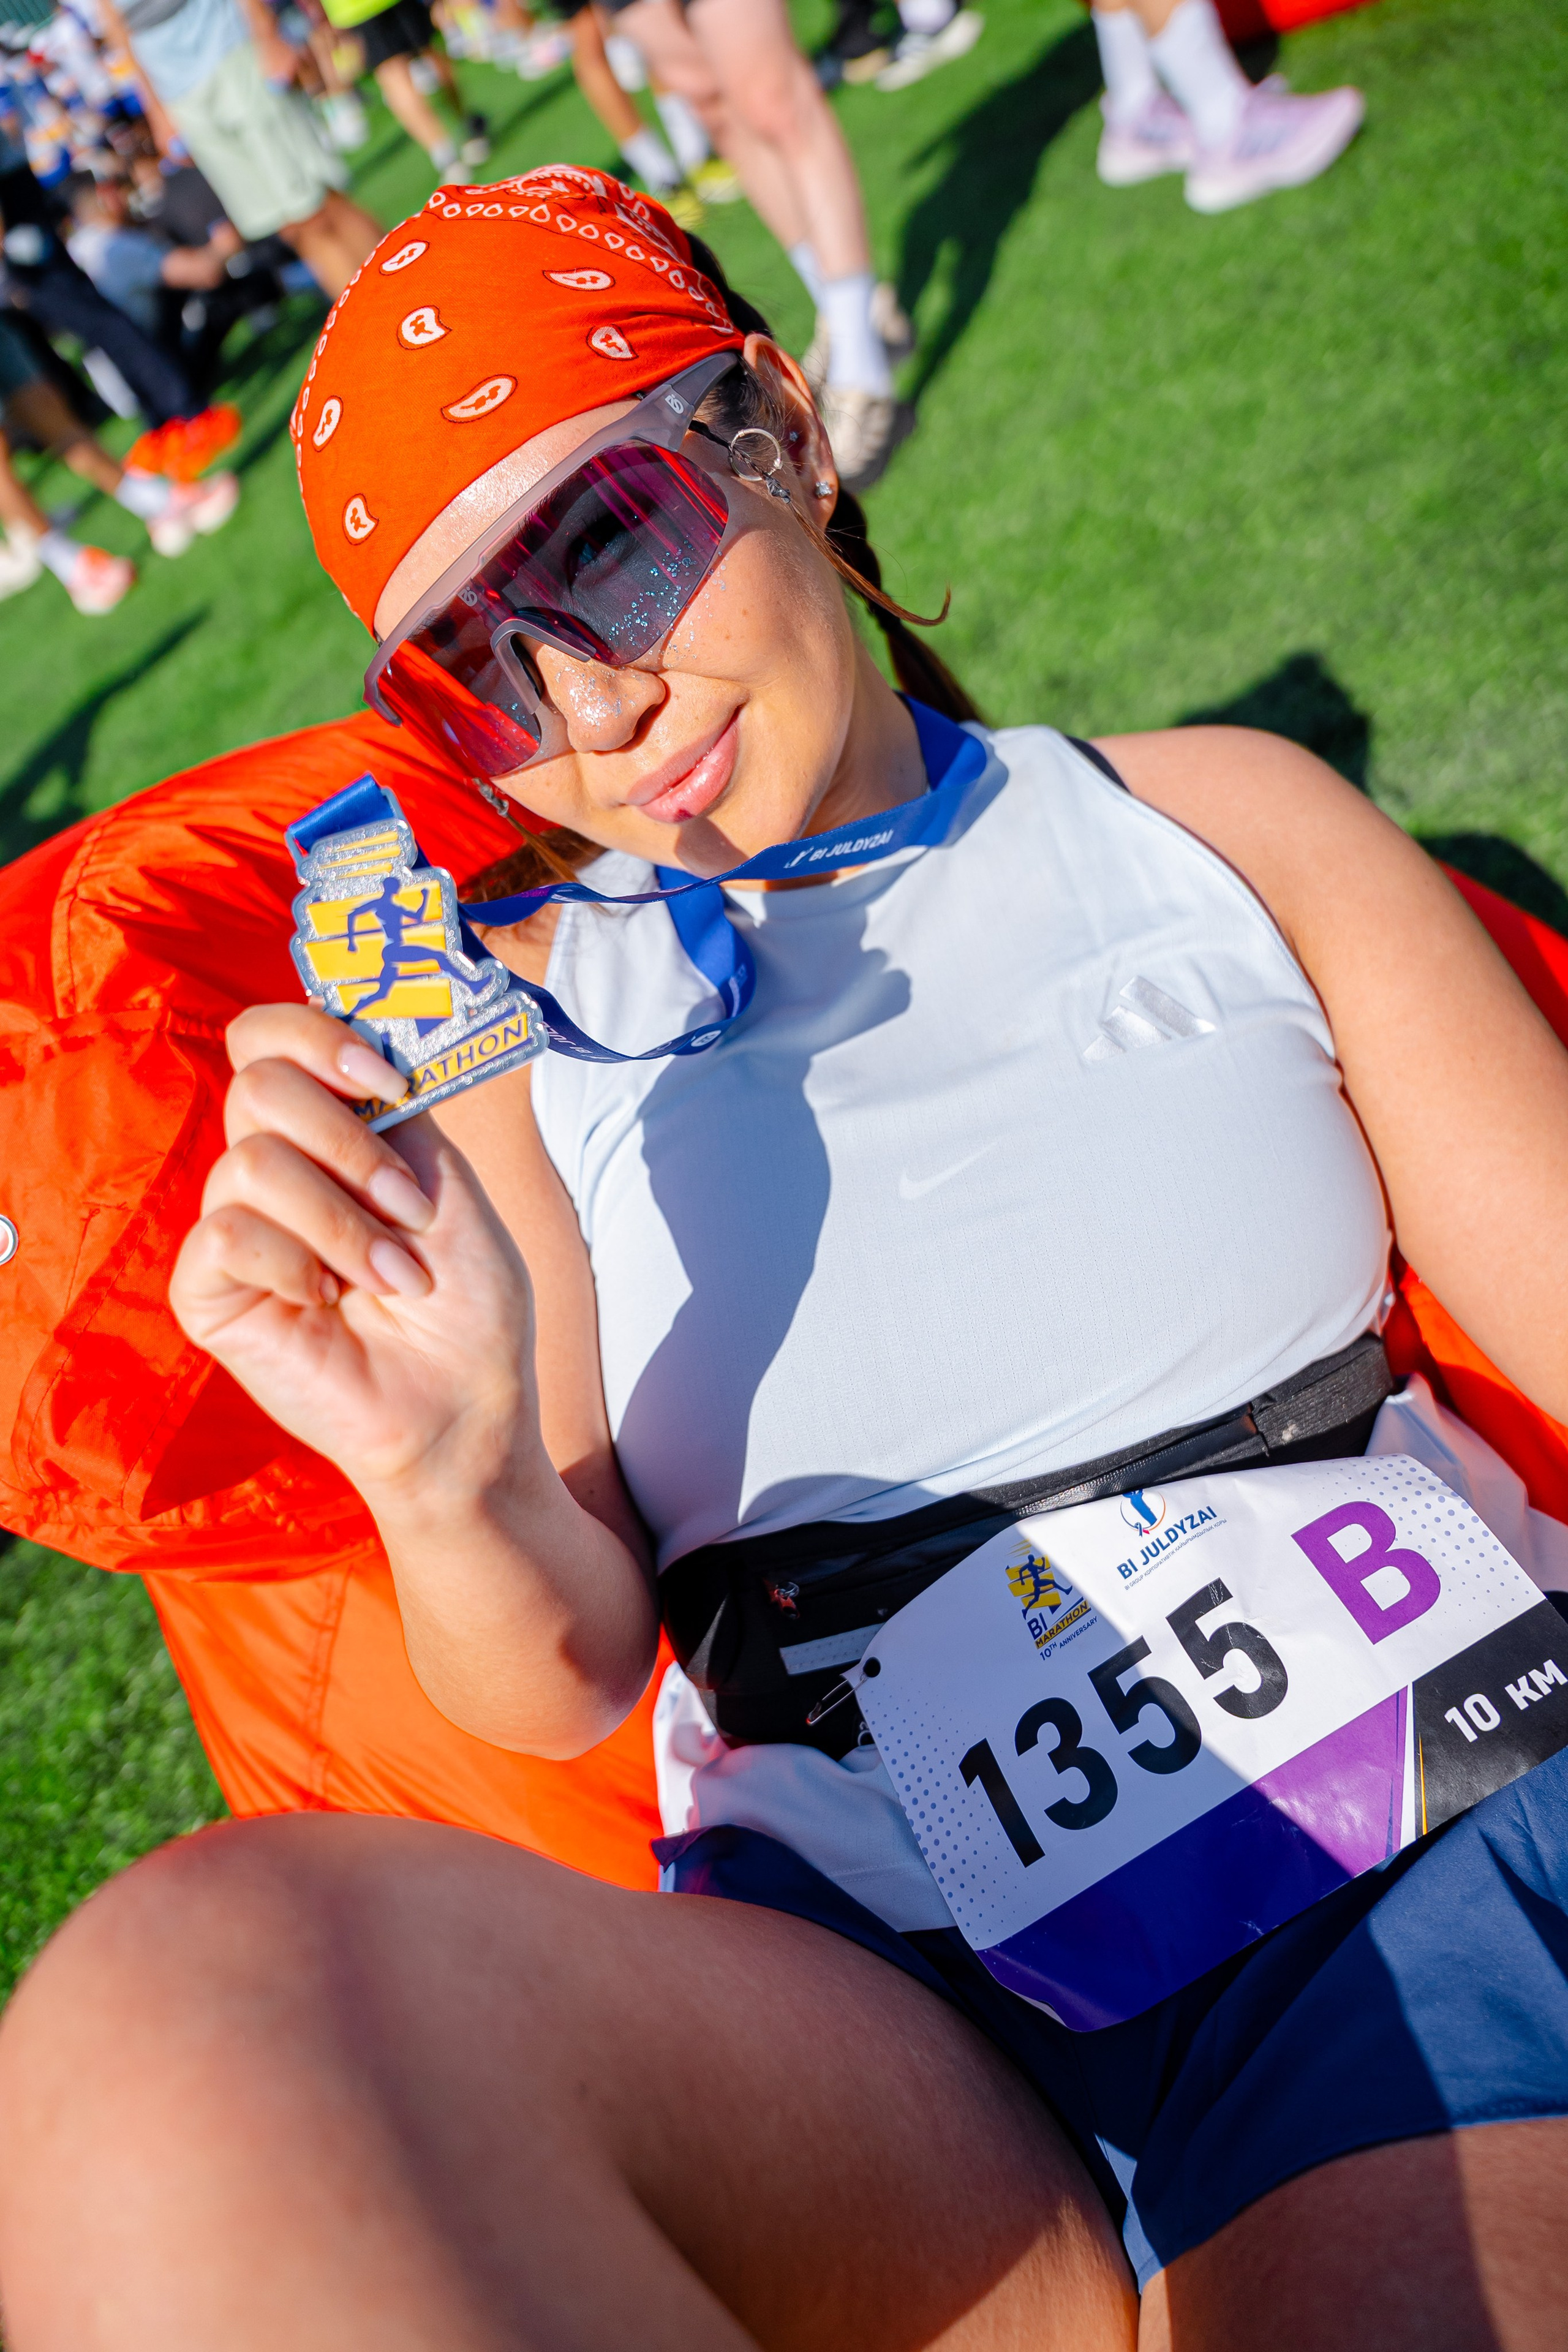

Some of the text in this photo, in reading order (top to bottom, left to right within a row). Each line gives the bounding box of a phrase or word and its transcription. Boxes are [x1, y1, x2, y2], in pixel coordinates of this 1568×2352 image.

[809, 828, 894, 862] BI JULDYZAI
[1117, 1506, 1218, 1580] BI JULDYZAI
[1129, 1575, 1144, 1588] GROUP
[1291, 1500, 1441, 1646] B
[1027, 1612, 1048, 1640] BI
[1035, 1600, 1088, 1648] MARATHON
[1059, 1616, 1098, 1649] ANNIVERSARY
[957, 1577, 1289, 1869] 1355
[1444, 1659, 1568, 1743] 10 KM
